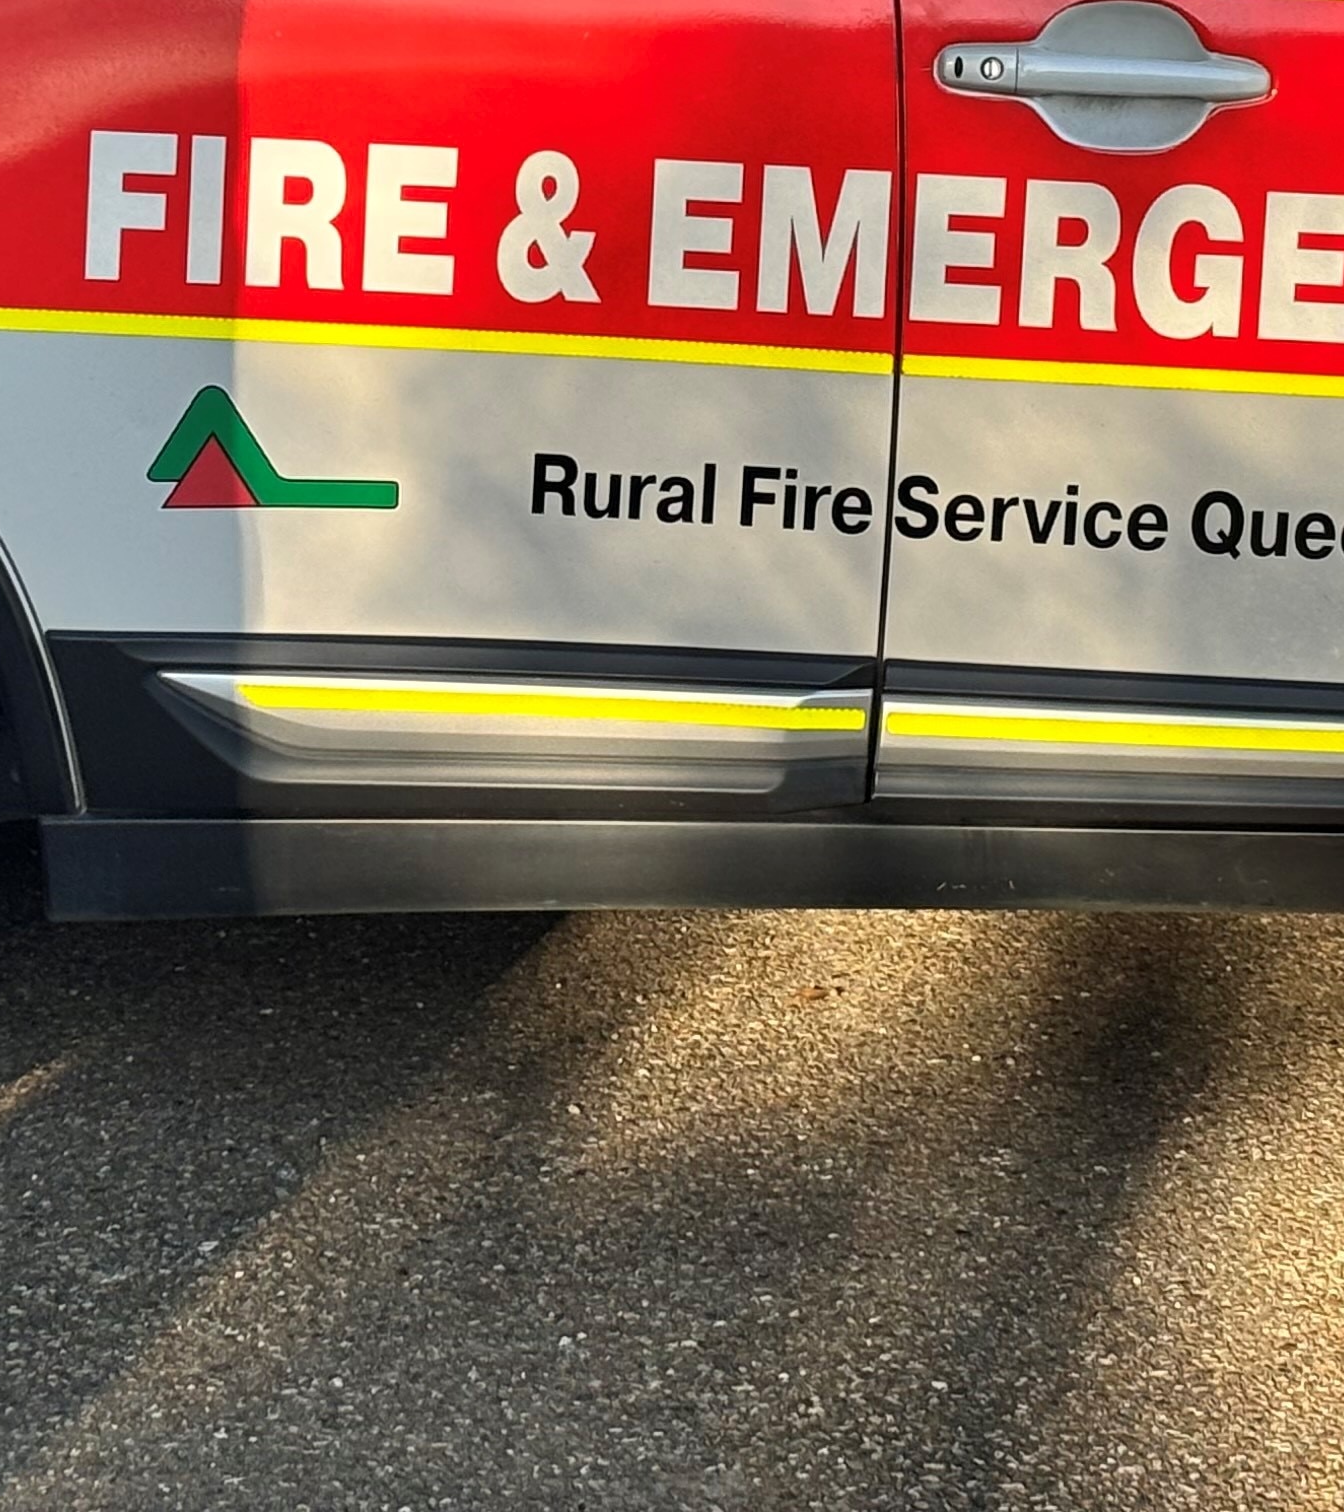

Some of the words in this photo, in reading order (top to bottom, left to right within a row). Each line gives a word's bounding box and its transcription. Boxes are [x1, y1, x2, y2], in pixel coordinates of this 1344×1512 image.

[84, 129, 459, 297] FIRE
[496, 149, 602, 304] &
[531, 452, 717, 525] Rural
[739, 466, 874, 536] Fire
[893, 474, 1170, 551] Service
